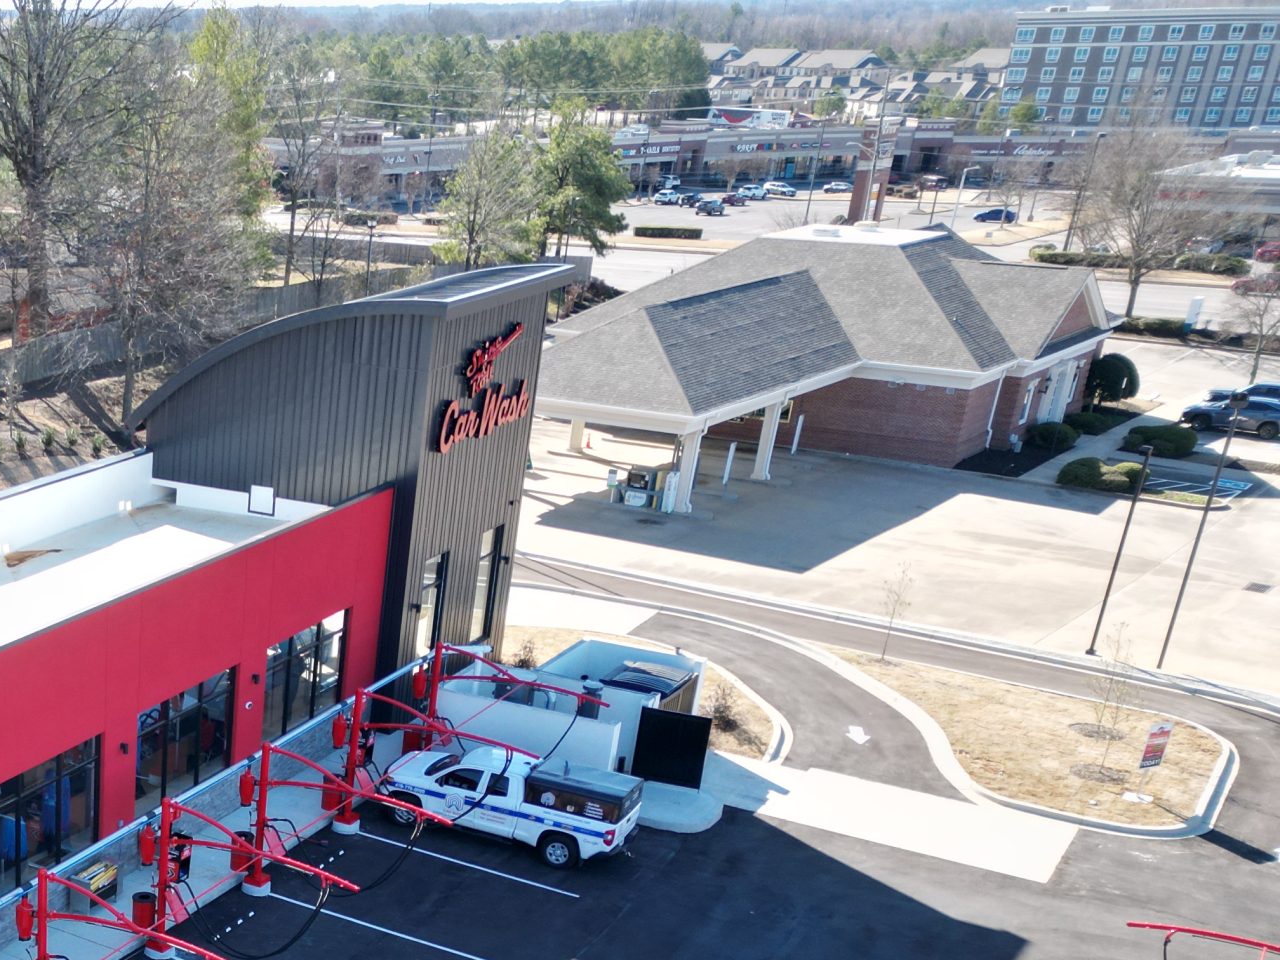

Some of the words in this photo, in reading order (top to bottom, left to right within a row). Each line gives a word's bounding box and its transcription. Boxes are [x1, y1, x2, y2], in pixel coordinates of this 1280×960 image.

[1012, 144, 1055, 156] Rainbow
[438, 399, 480, 455] Car
[479, 380, 531, 439] Wash
